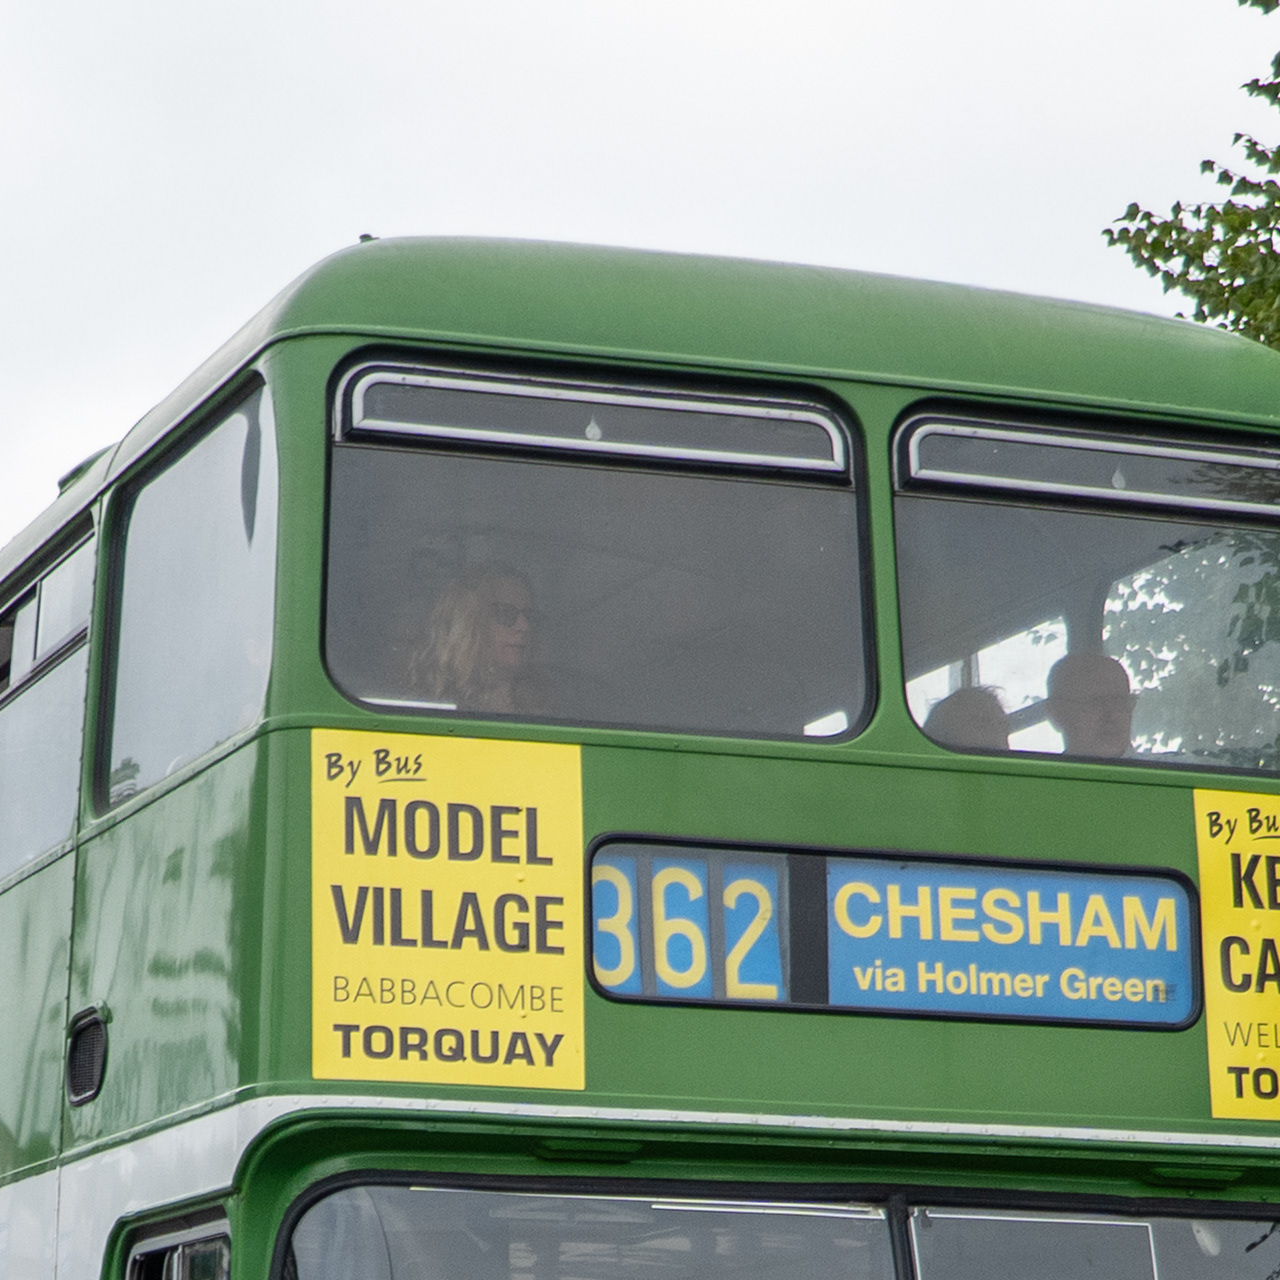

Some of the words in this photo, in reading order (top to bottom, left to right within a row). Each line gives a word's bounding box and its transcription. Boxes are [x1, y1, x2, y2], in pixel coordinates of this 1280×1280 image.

[325, 752, 362, 788] By
[373, 748, 424, 777] Bus
[344, 796, 554, 867] MODEL
[1206, 811, 1238, 845] By
[330, 884, 566, 956] VILLAGE
[591, 865, 779, 1001] 362
[833, 881, 1178, 952] CHESHAM
[333, 975, 565, 1014] BABBACOMBE
[852, 959, 905, 993] via
[917, 961, 1050, 998] Holmer
[1059, 967, 1168, 1004] Green
[332, 1023, 566, 1068] TORQUAY
